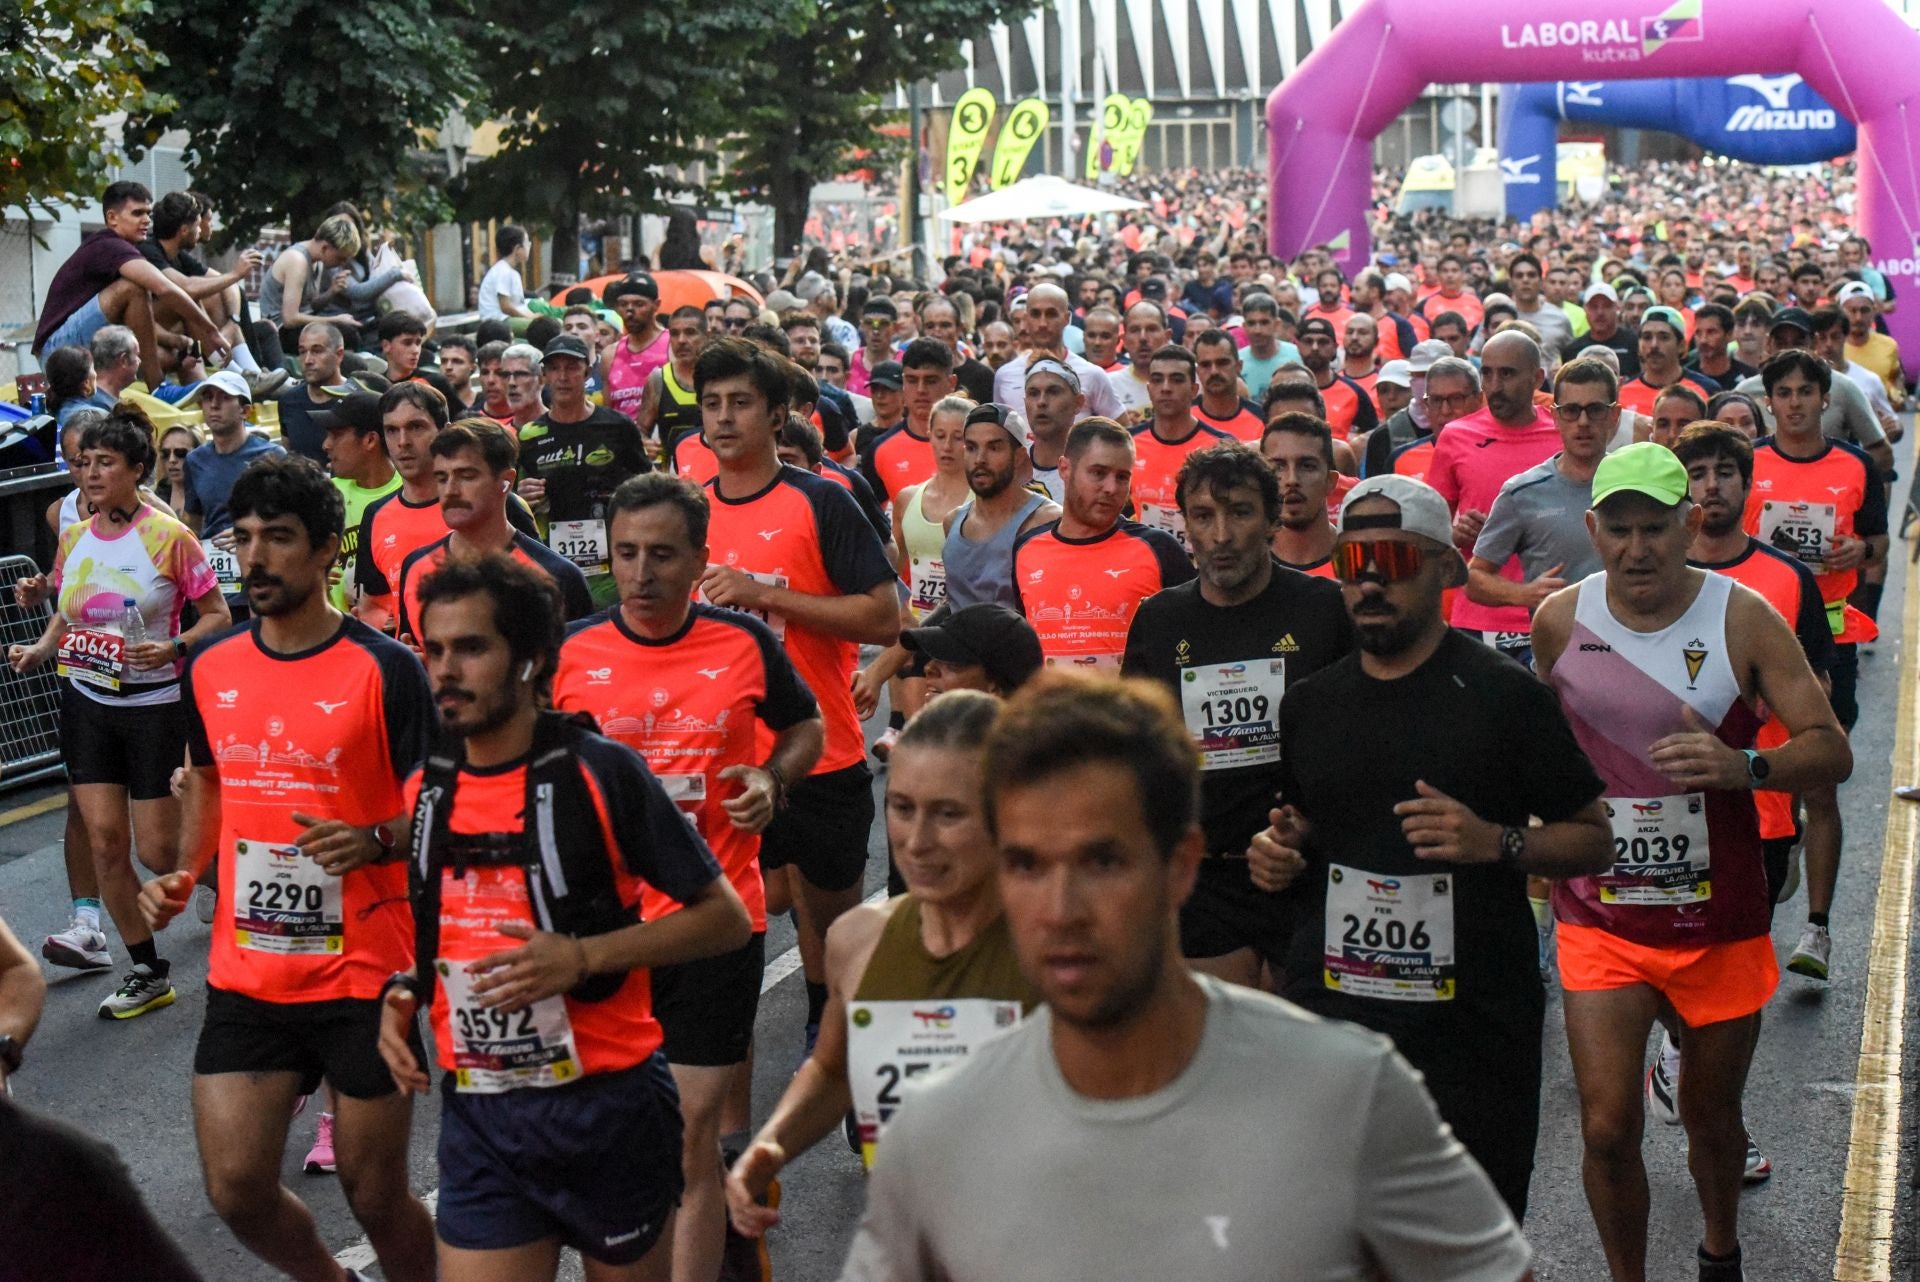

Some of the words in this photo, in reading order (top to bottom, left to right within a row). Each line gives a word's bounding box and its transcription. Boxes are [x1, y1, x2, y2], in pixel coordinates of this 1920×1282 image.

[1501, 20, 1638, 48] LABORAL
[1582, 46, 1640, 62] kutxa
[1725, 106, 1836, 131] MIZUNO
[558, 540, 598, 555] 3122
[919, 579, 947, 597] 273
[63, 633, 120, 662] 20642
[1579, 644, 1612, 653] KON
[1201, 695, 1269, 726] 1309
[1227, 726, 1267, 737] MIZUNO
[1615, 834, 1690, 864] 2039
[1642, 867, 1685, 877] MIZUNO
[248, 880, 323, 910] 2290
[1700, 887, 1707, 896] 3
[1374, 906, 1392, 915] FER
[1343, 913, 1431, 951] 2606
[1373, 953, 1424, 966] MIZUNO
[456, 1005, 539, 1039] 3592
